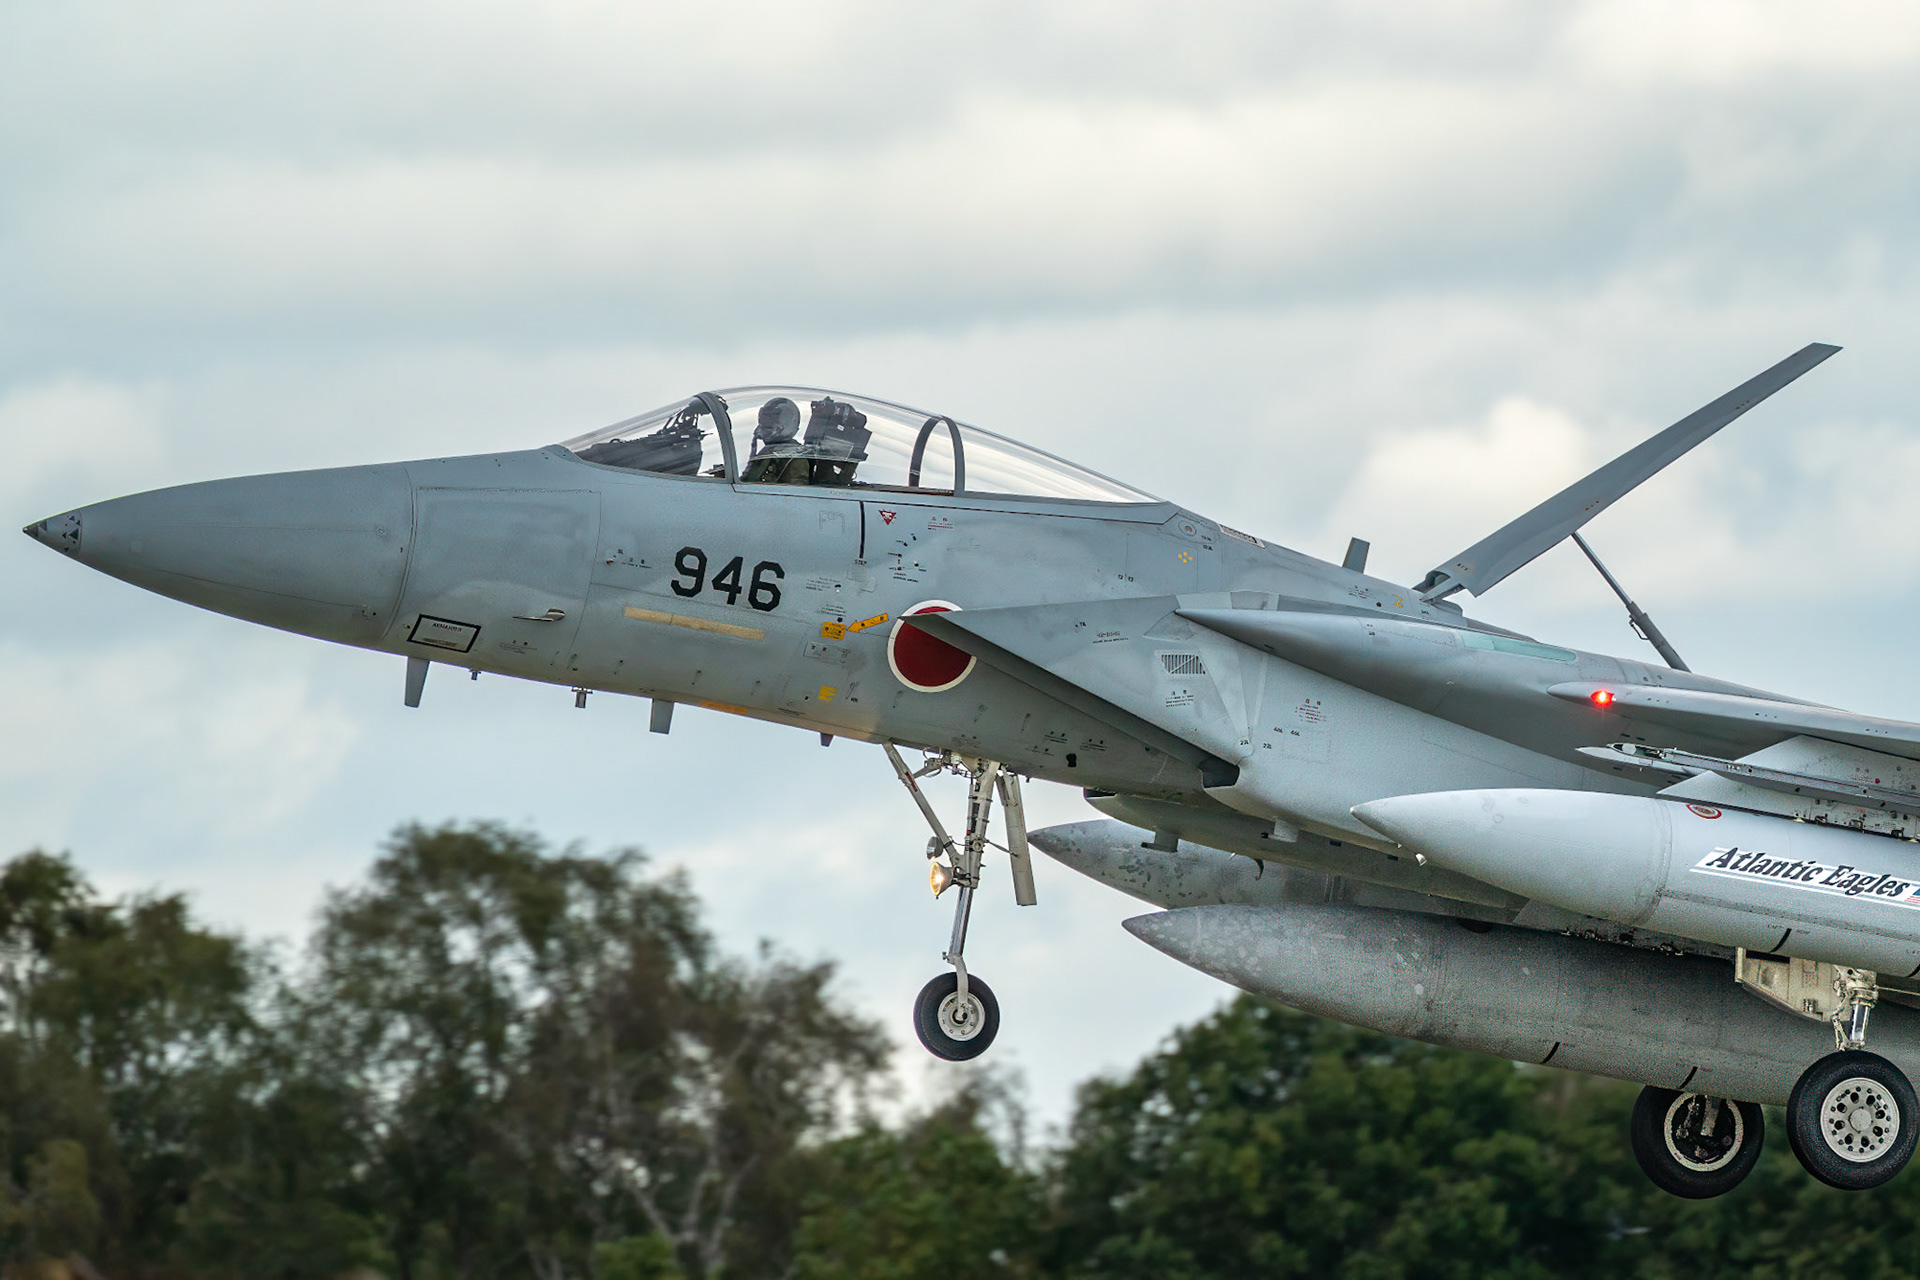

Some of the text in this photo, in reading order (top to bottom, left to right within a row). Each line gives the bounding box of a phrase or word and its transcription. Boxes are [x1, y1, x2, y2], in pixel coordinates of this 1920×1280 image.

[670, 546, 785, 612] 946
[1706, 847, 1910, 896] Atlantic Eagles
